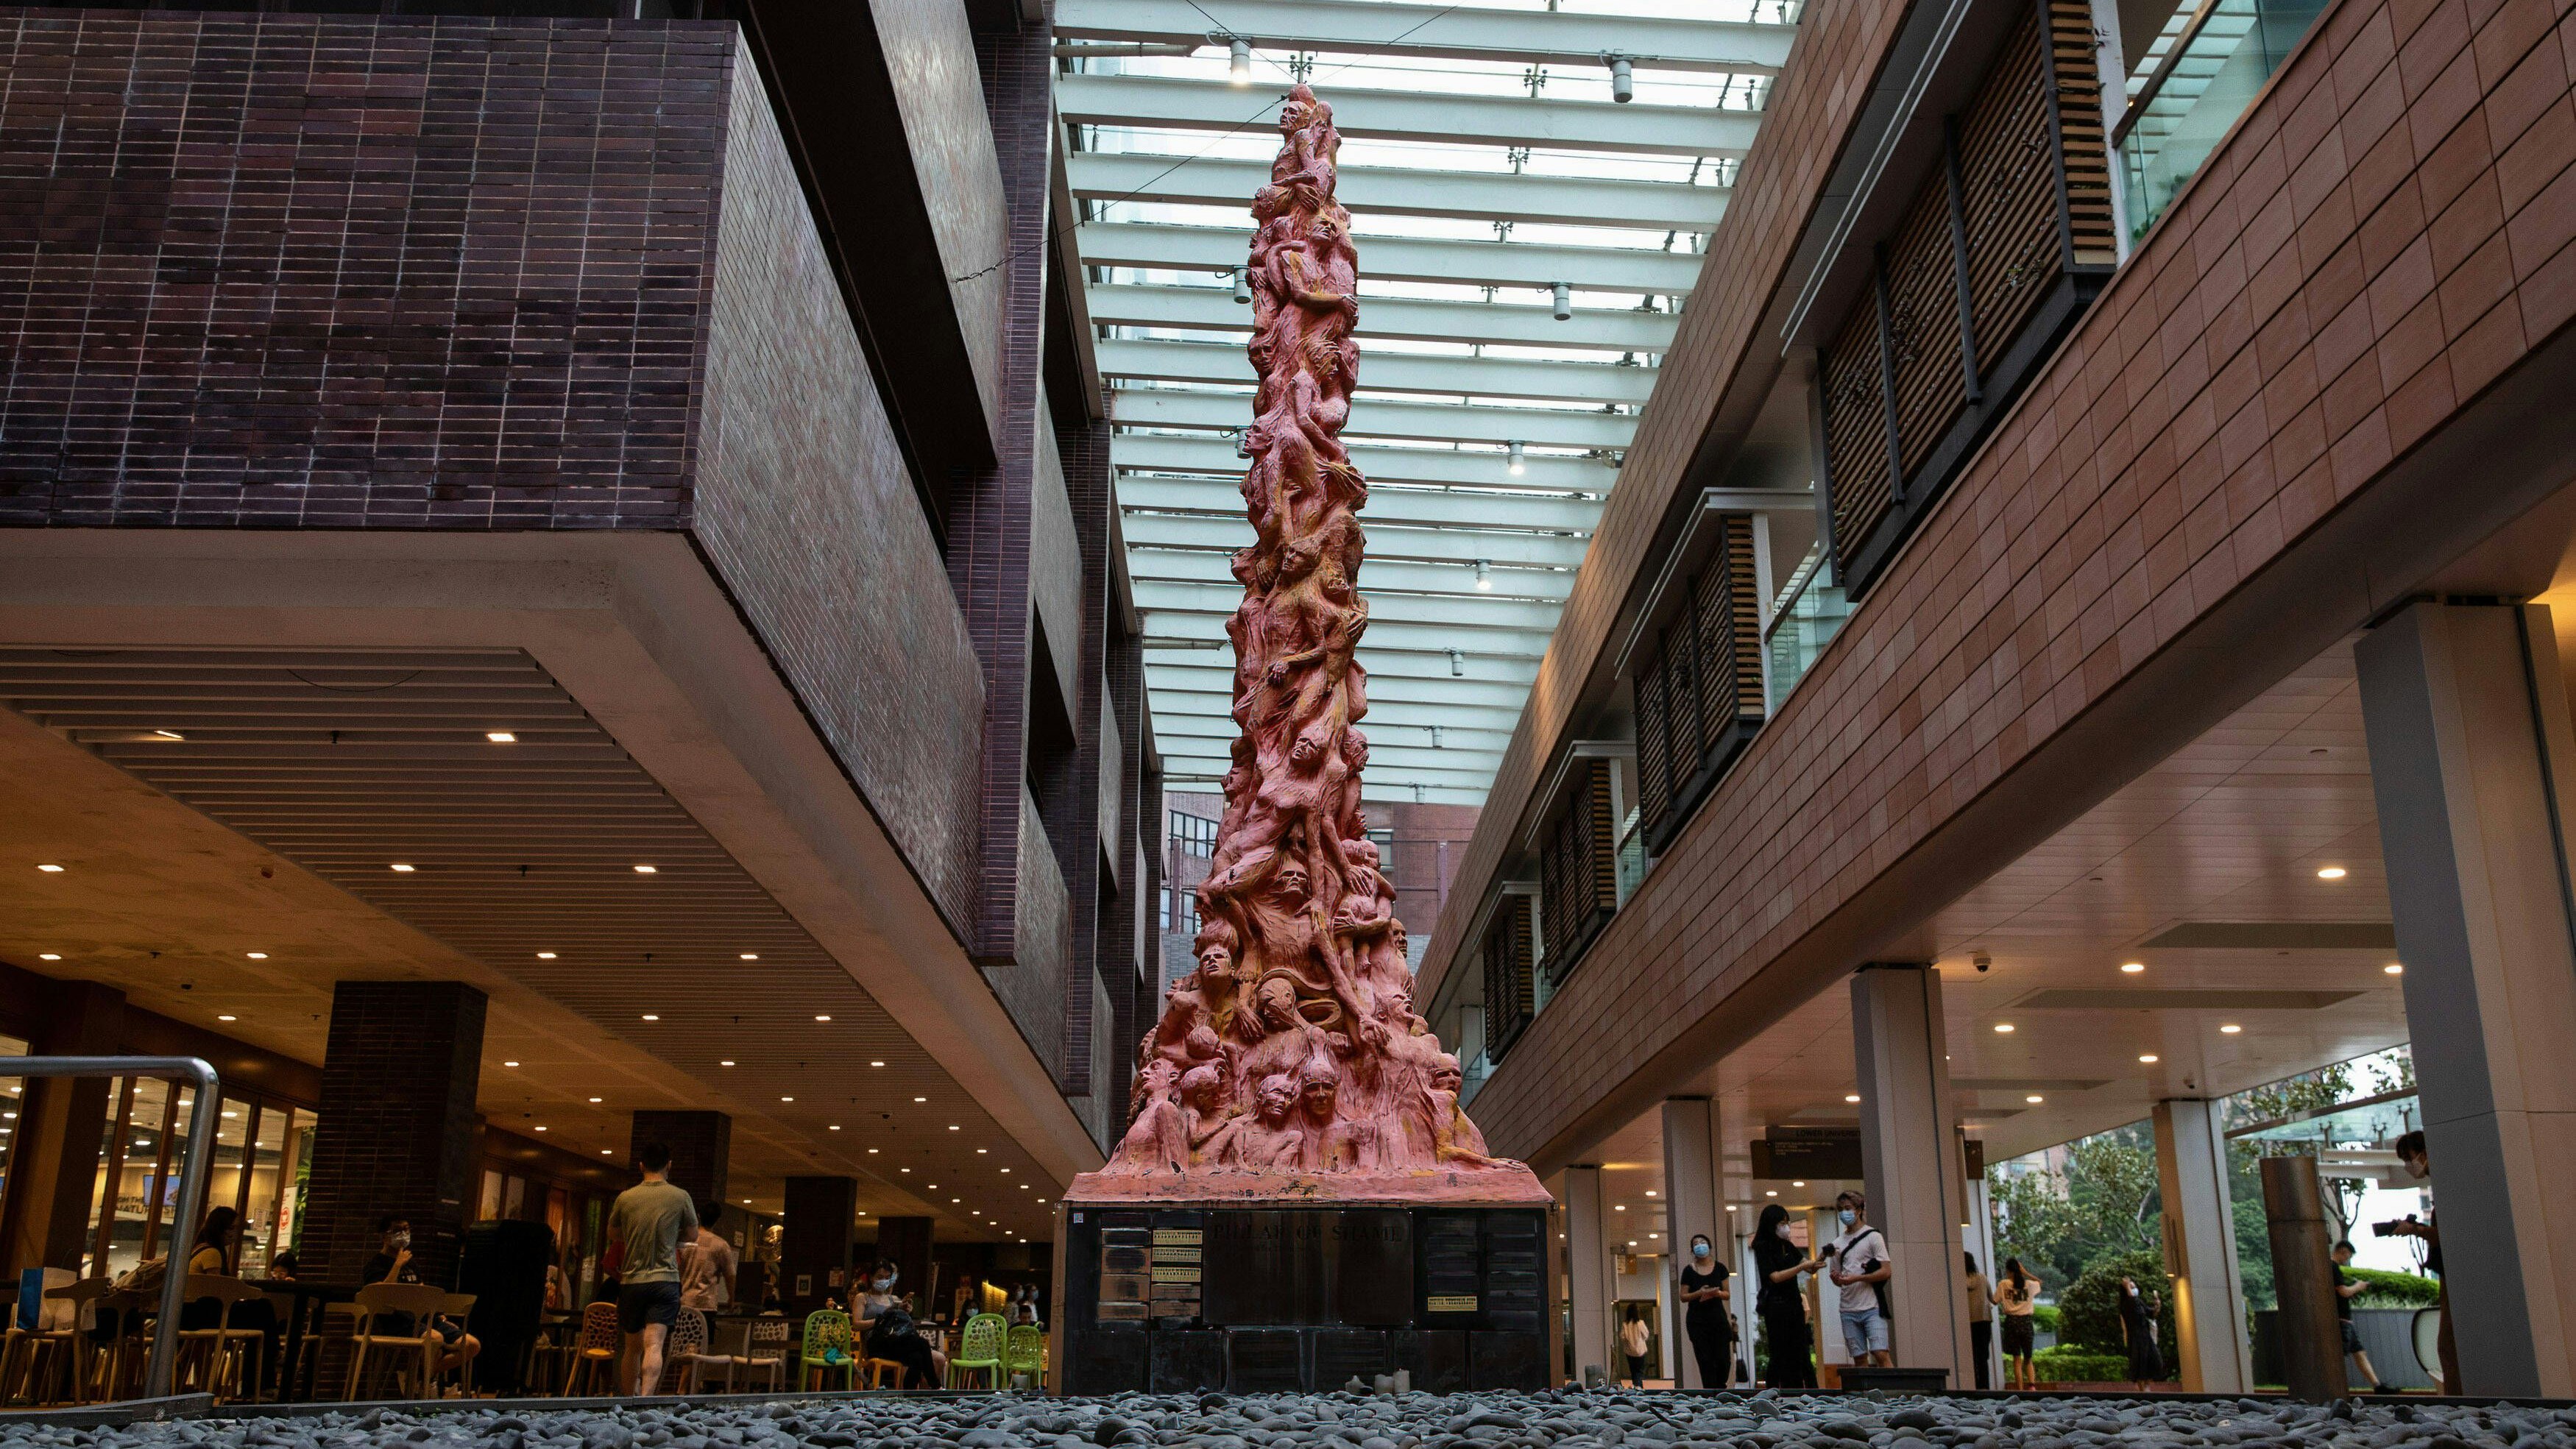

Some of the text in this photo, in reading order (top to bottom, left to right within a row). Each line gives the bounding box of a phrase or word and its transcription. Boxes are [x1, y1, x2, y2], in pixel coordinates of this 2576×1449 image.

[1213, 1225, 1284, 1240] PILLAR
[1296, 1225, 1323, 1240] OF
[1331, 1225, 1402, 1242] SHAME
